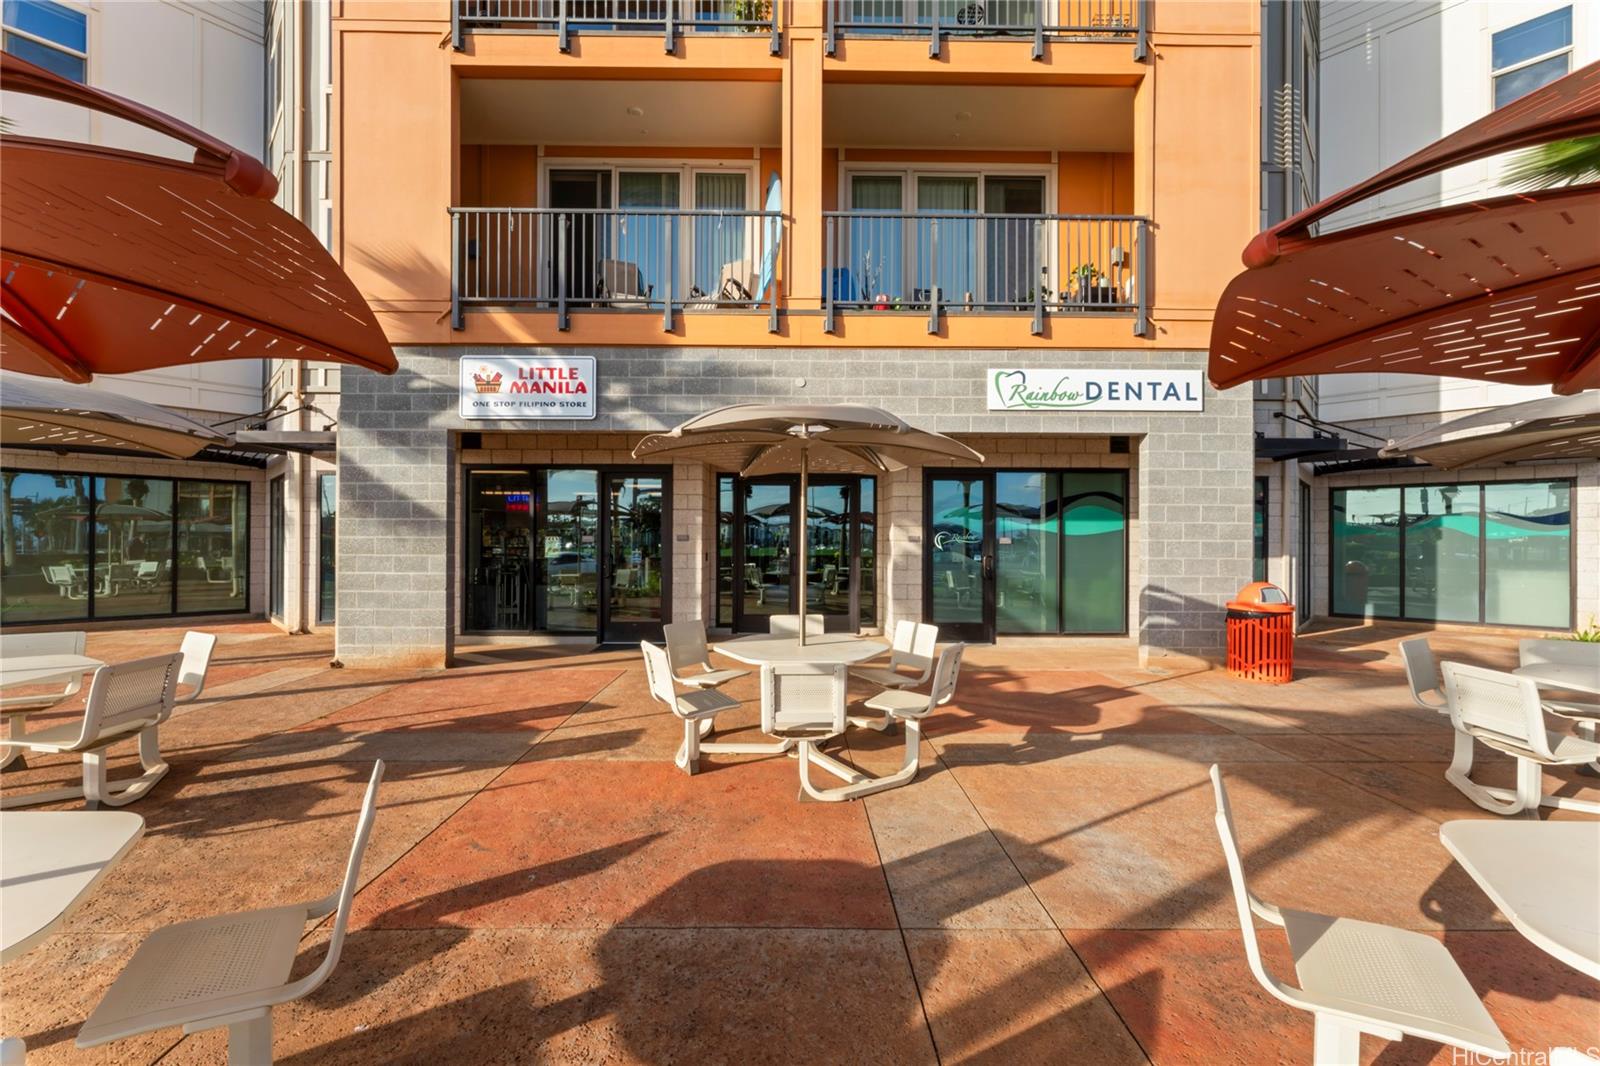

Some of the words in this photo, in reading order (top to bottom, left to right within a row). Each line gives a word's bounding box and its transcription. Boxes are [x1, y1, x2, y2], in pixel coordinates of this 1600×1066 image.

[518, 367, 579, 380] LITTLE
[509, 381, 588, 394] MANILA
[1009, 376, 1083, 406] Rainbow
[1085, 381, 1198, 401] DENTAL
